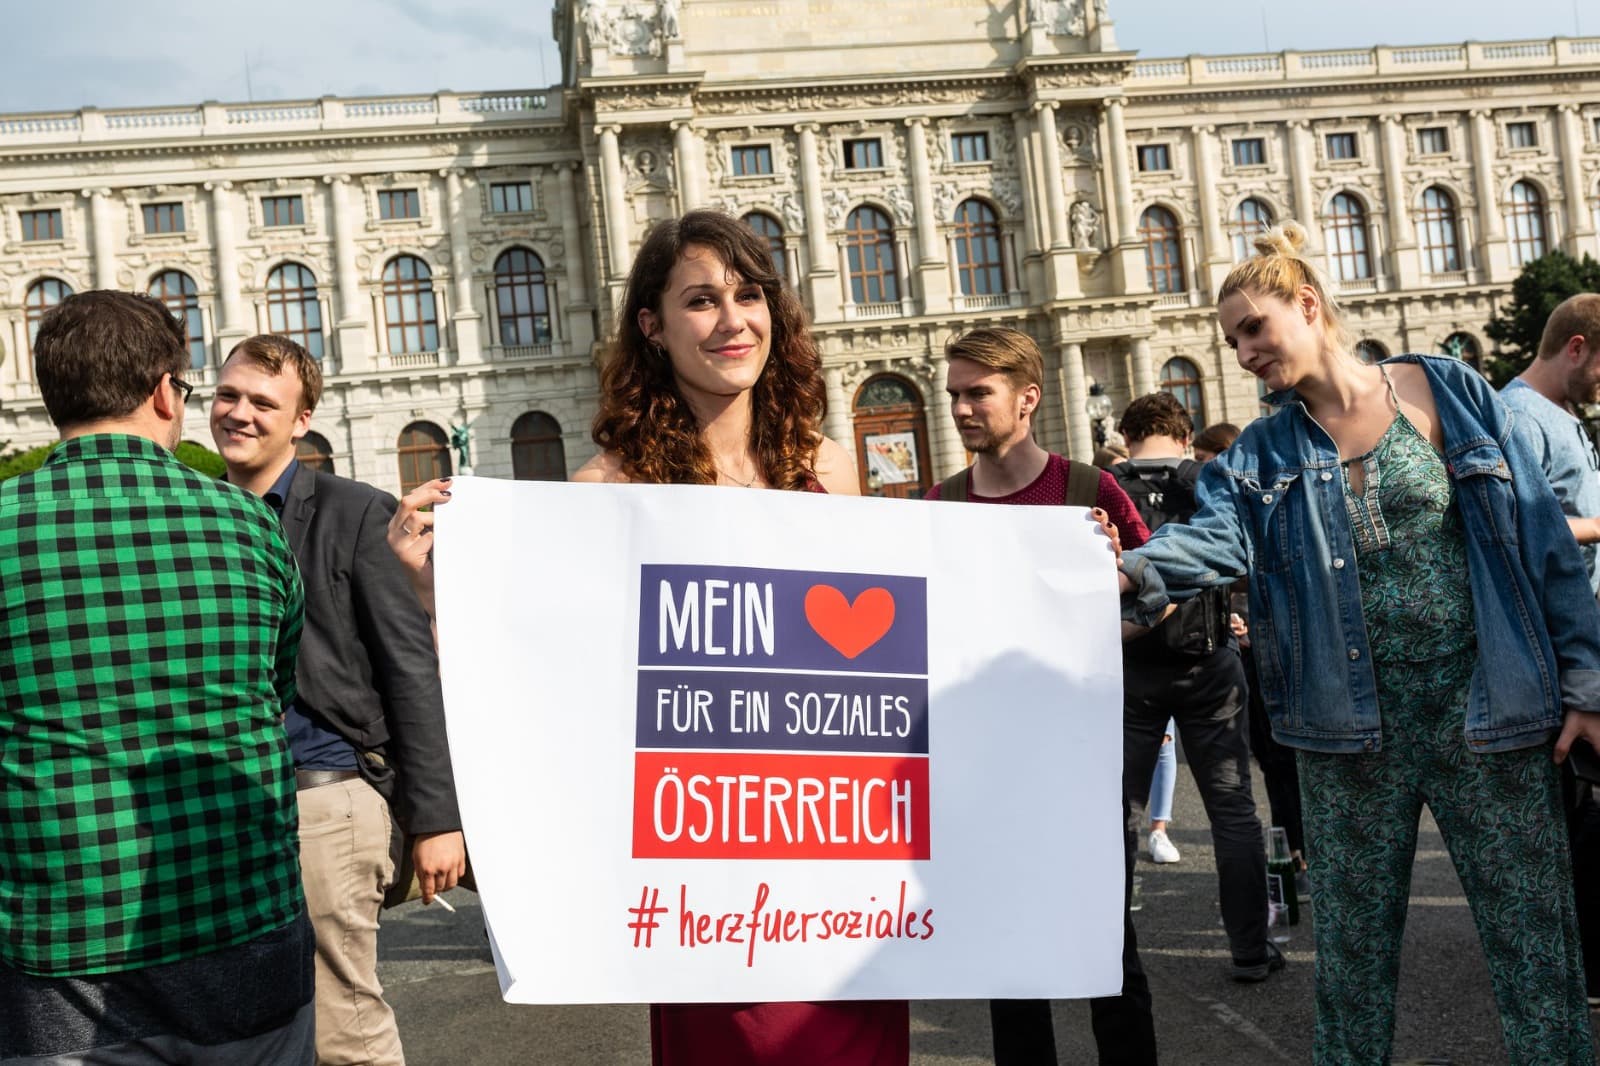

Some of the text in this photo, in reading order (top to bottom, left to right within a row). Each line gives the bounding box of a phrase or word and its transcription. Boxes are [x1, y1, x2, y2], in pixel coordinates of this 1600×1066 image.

[659, 579, 775, 656] MEIN
[656, 685, 911, 738] FÜR EIN SOZIALES
[652, 766, 912, 845] ÖSTERREICH
